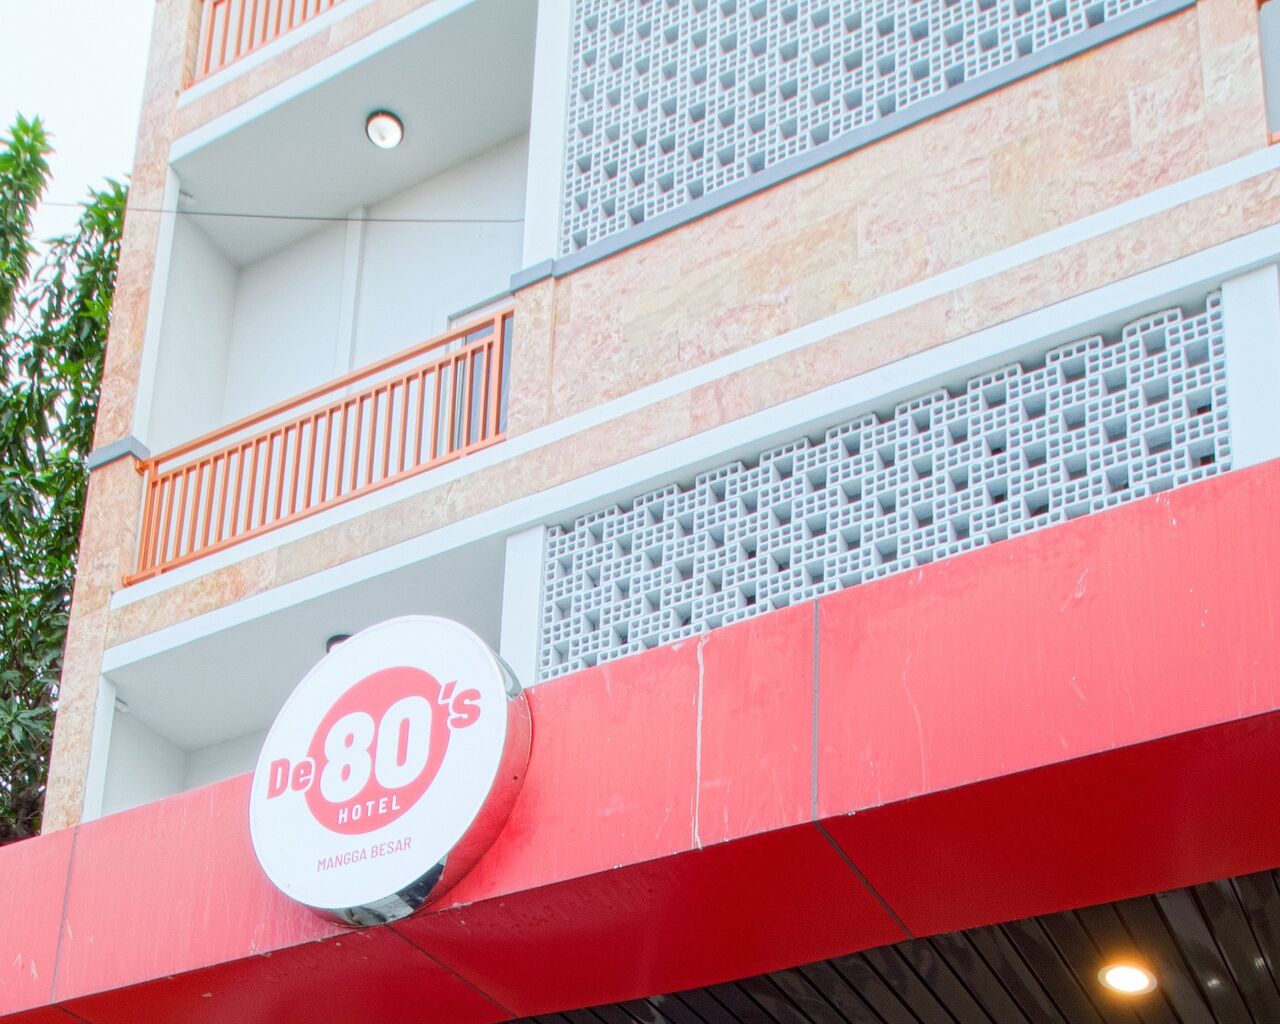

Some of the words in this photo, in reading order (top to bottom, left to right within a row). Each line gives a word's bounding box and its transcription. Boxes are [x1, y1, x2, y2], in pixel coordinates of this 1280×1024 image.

[267, 758, 313, 800] De
[338, 795, 400, 824] HOTEL
[317, 847, 367, 872] MANGGA
[371, 836, 412, 858] BESAR
